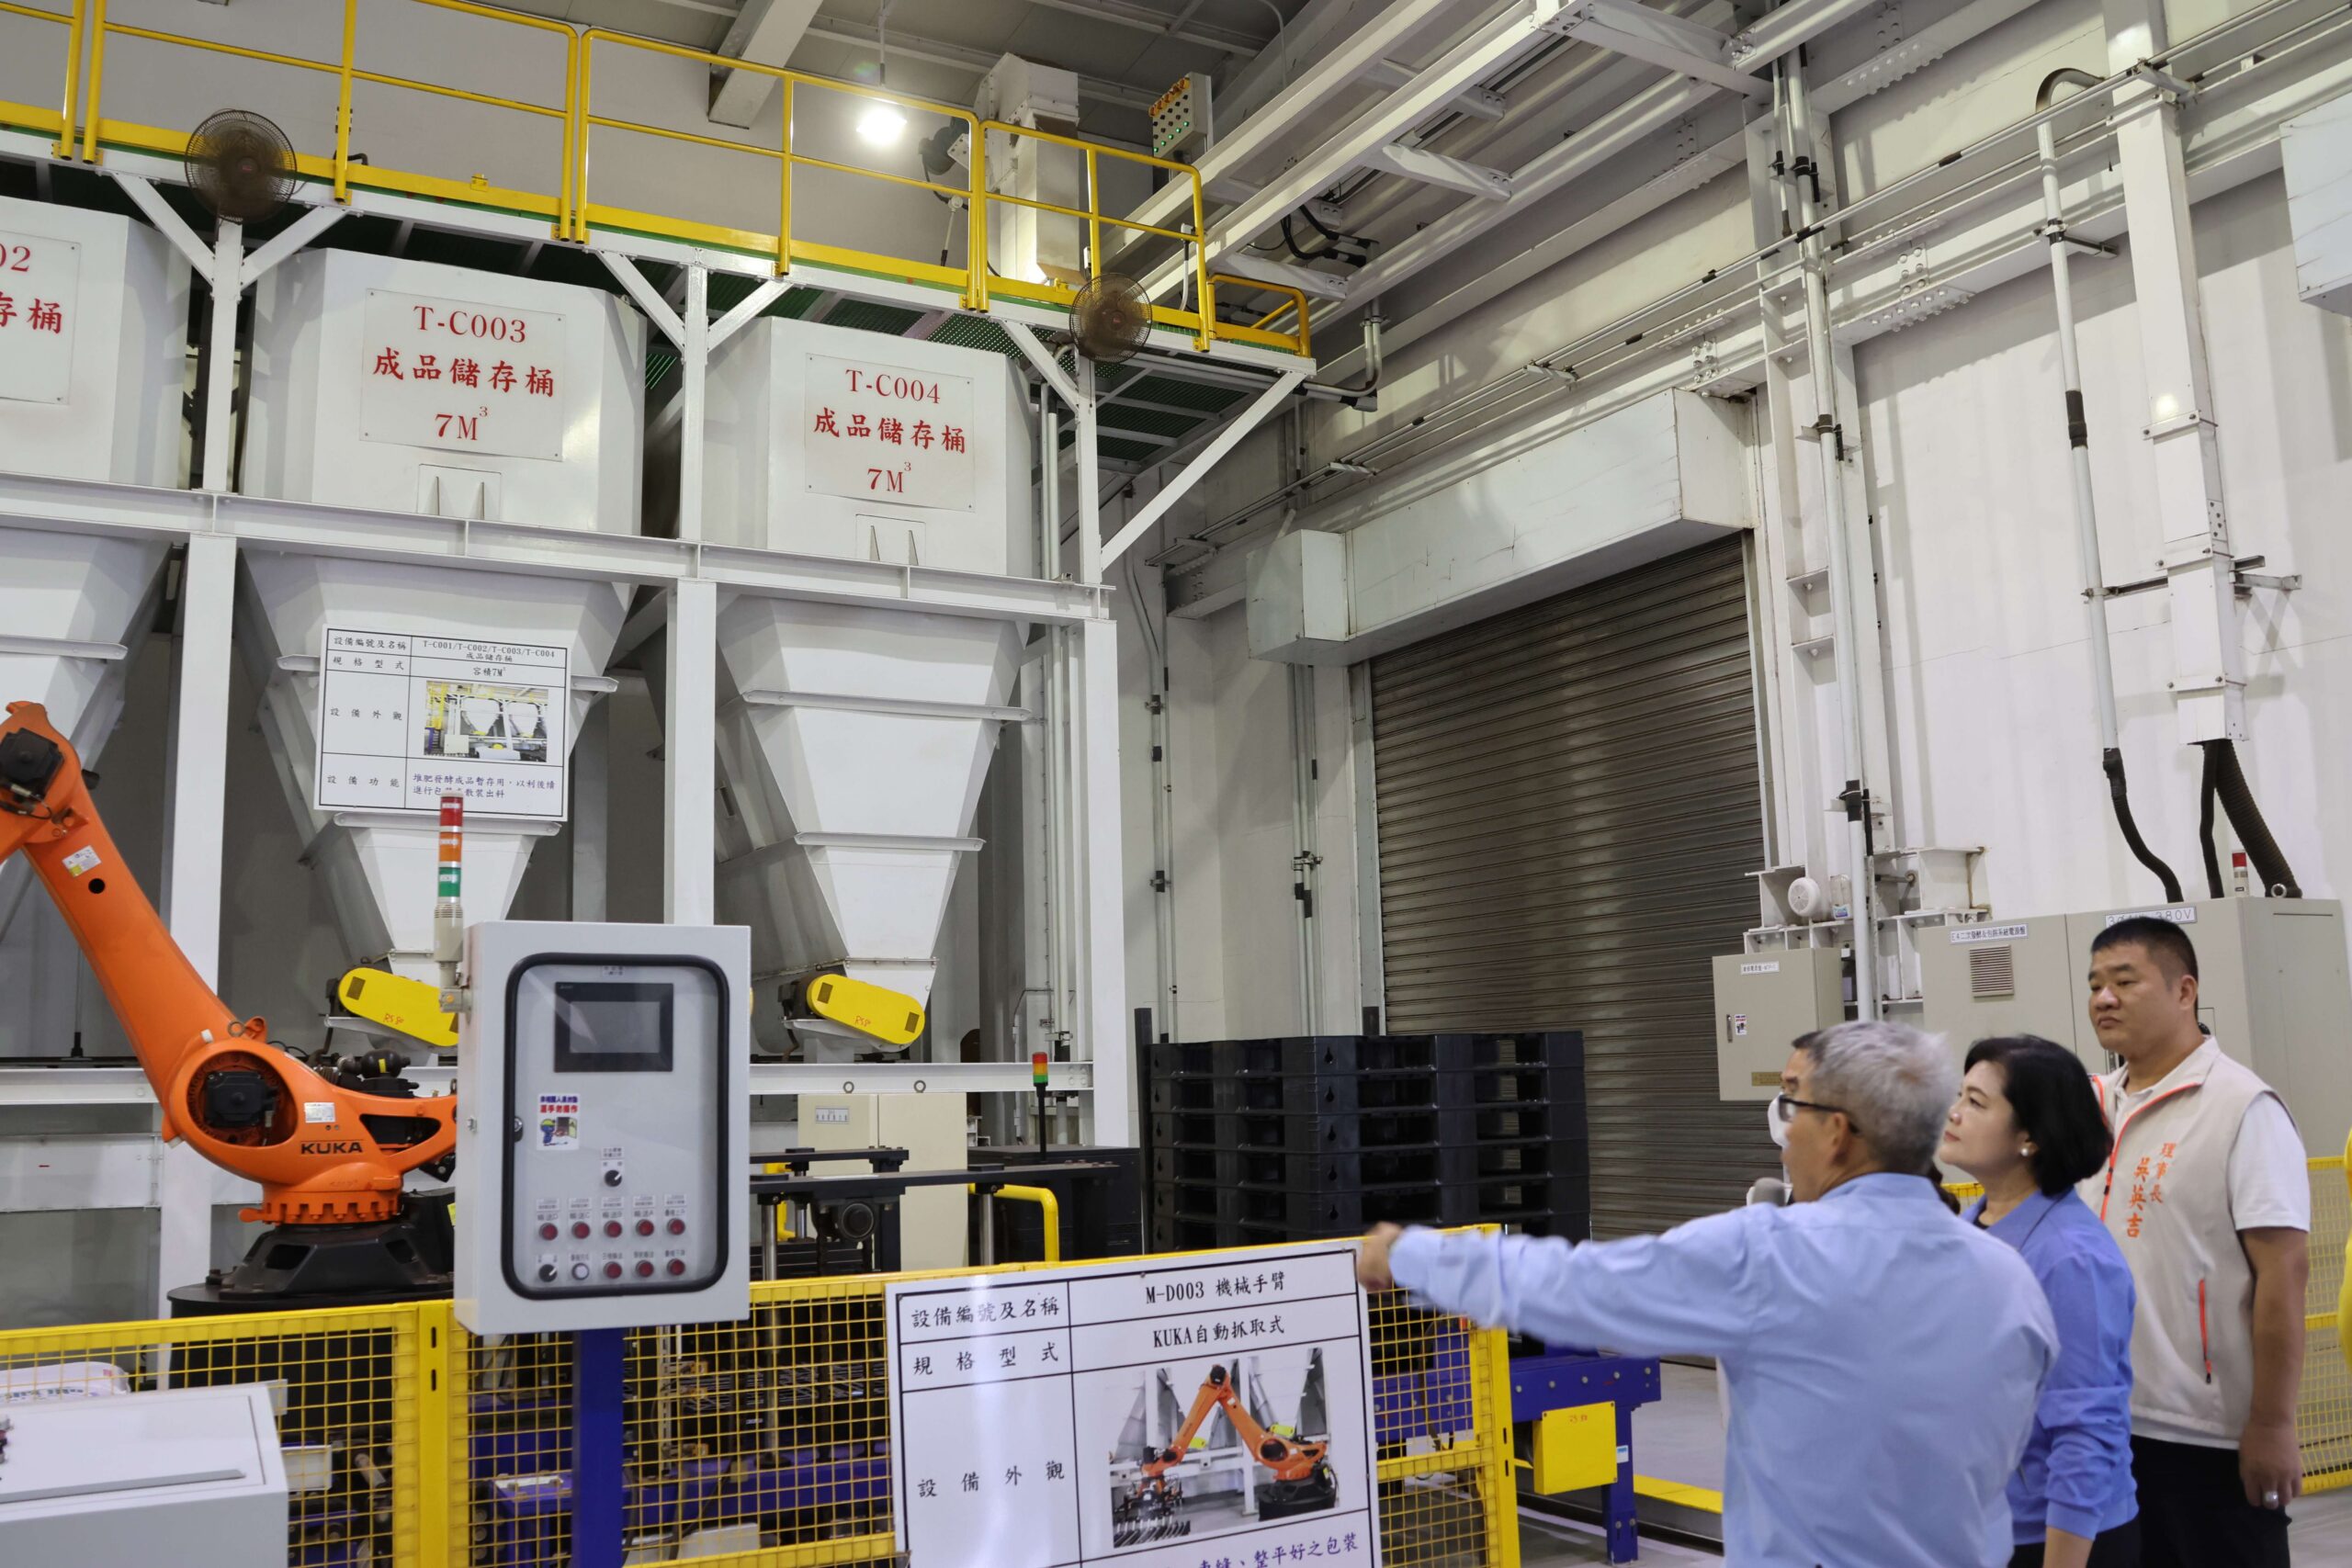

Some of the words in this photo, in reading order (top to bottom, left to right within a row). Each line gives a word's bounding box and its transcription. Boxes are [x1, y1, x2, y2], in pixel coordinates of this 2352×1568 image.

[413, 305, 526, 344] T-C003
[373, 346, 555, 398] 成品儲存桶
[845, 368, 941, 404] T-C004
[814, 406, 967, 455] 成品儲存桶
[334, 637, 406, 651] 設備編號及名稱
[300, 1142, 364, 1155] KUKA
[2151, 1143, 2177, 1203] 理事長
[1146, 1280, 1204, 1304] M-D003
[1216, 1270, 1285, 1297] 機械手臂
[910, 1296, 1060, 1328] 設備編號及名稱
[1153, 1314, 1285, 1348] KUKA自動抓取式
[913, 1341, 1059, 1376] 規格型式
[917, 1460, 1065, 1498] 設備外觀
